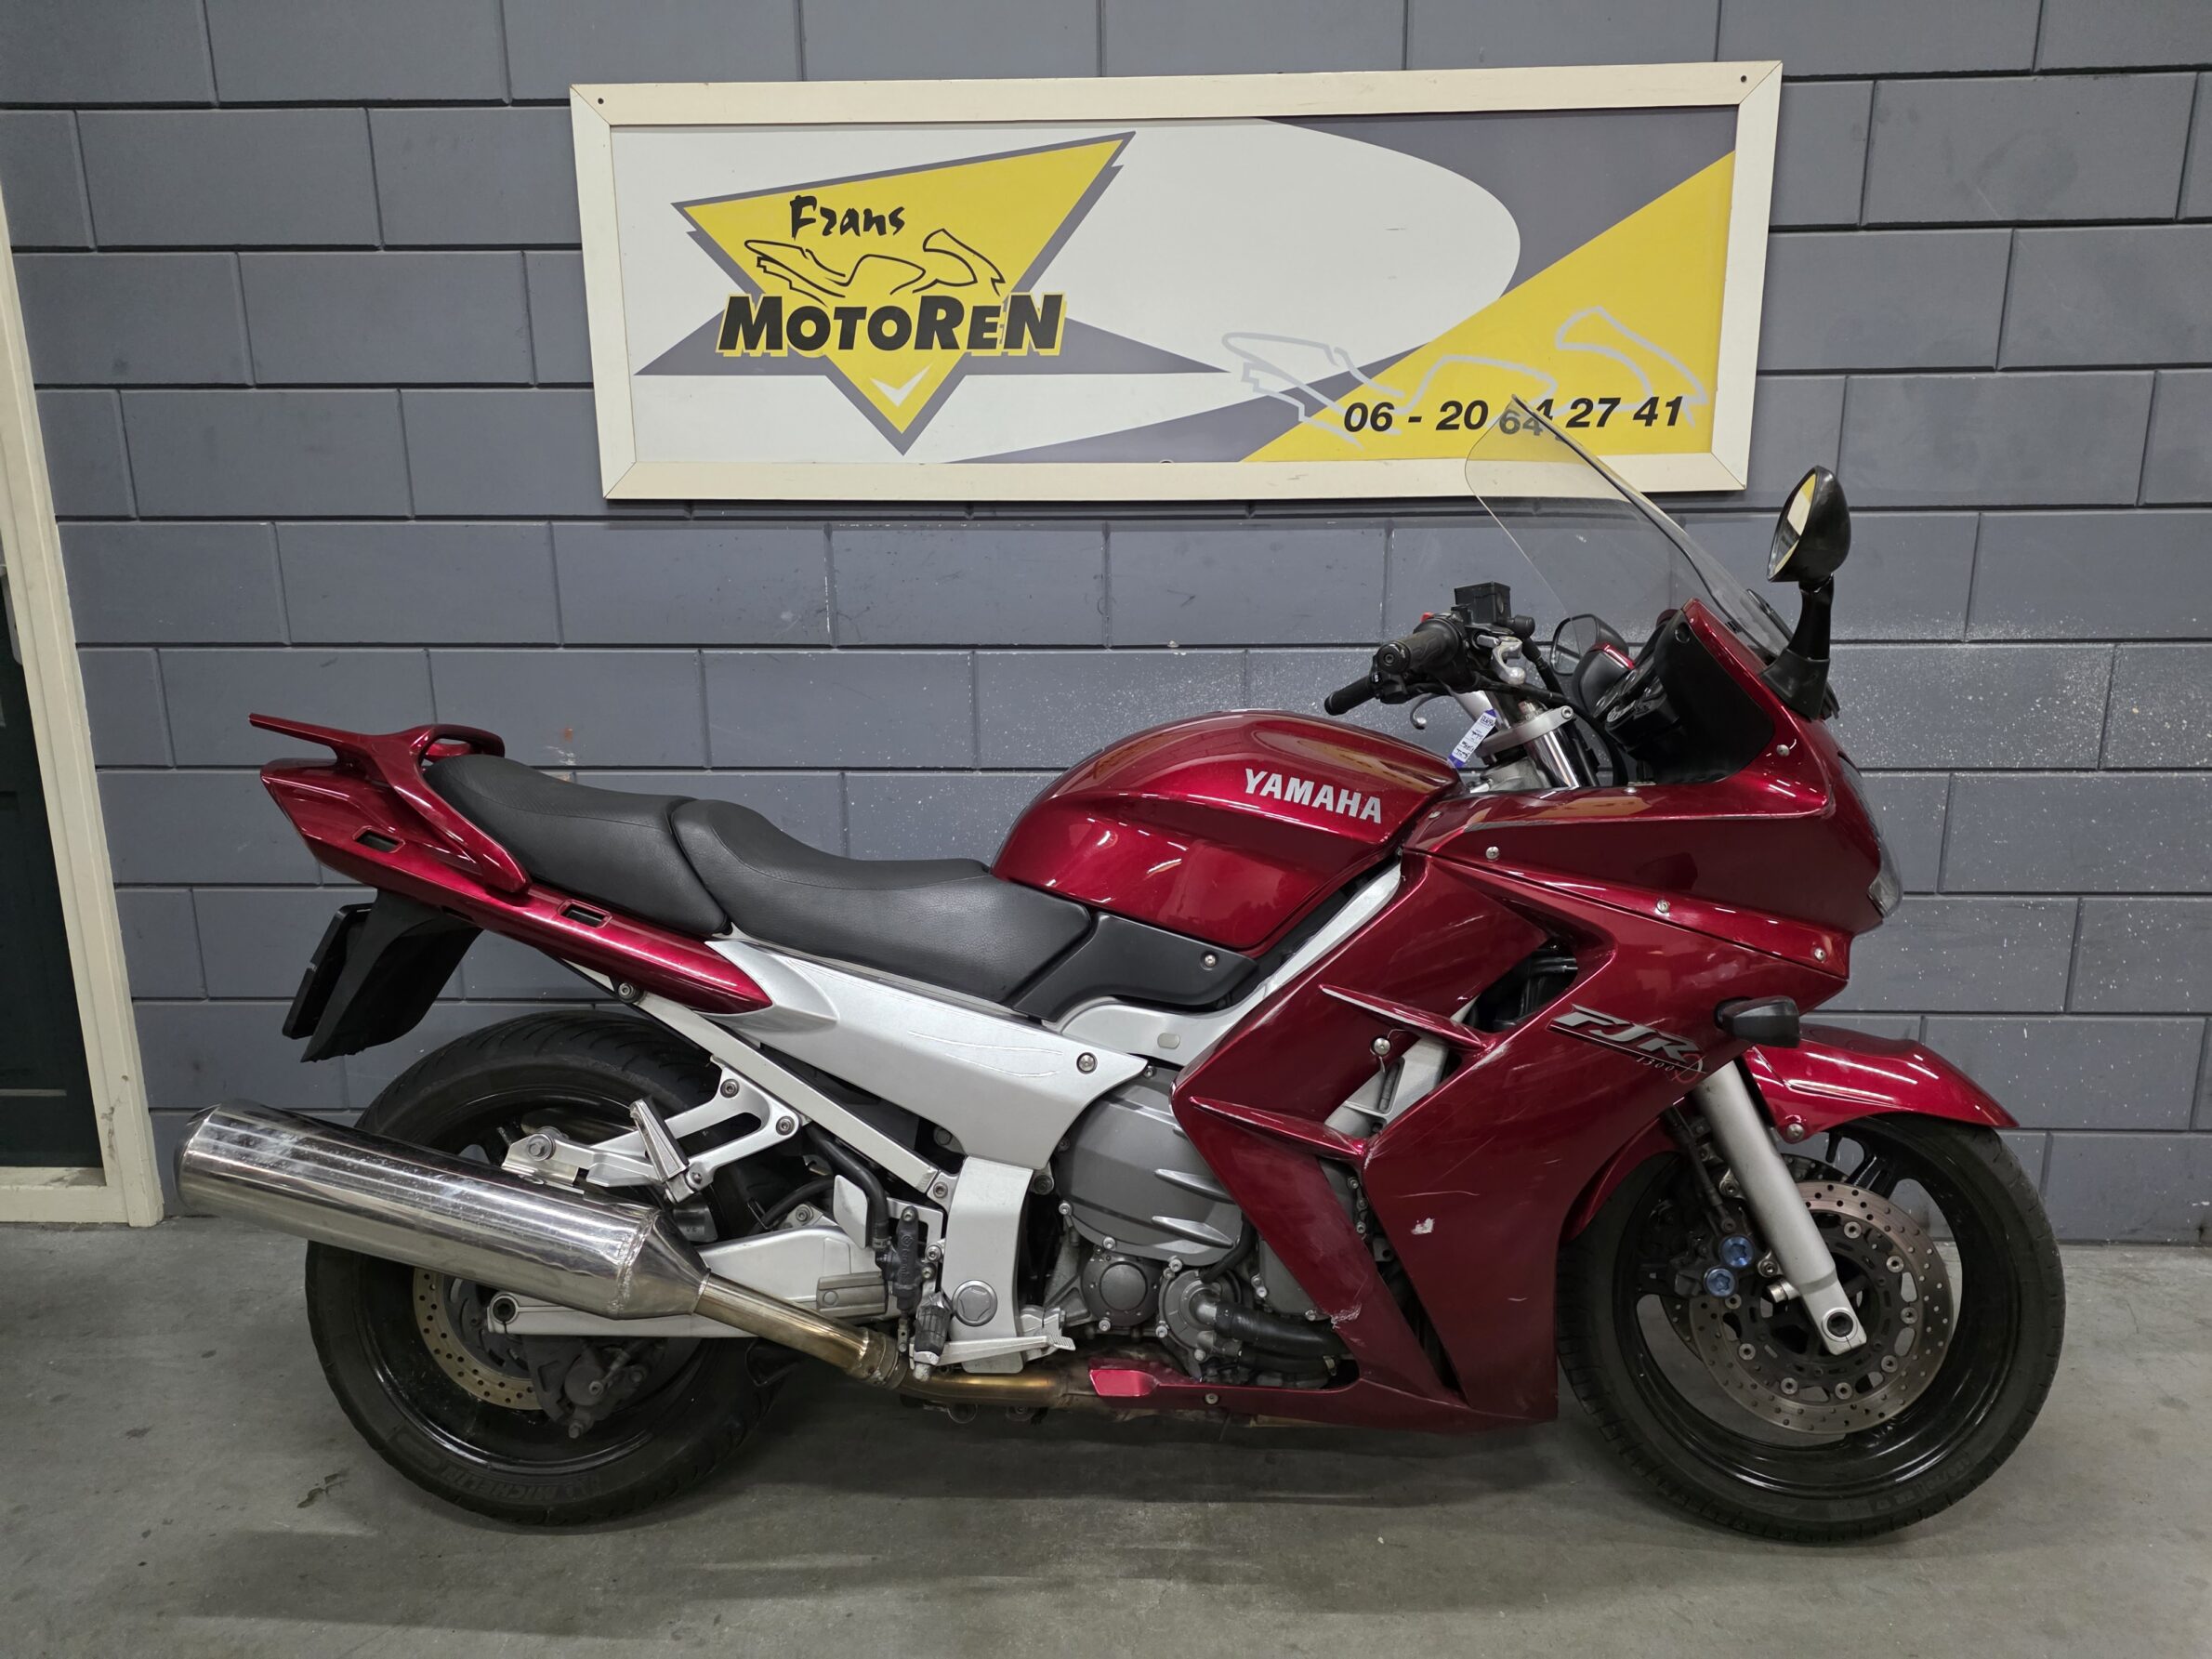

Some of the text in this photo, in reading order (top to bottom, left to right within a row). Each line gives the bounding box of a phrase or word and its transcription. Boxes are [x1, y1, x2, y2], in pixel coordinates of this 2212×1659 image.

[789, 195, 905, 239] Frans
[1343, 395, 1684, 437] 06 - 20 64 27 41
[1244, 768, 1382, 824] YAMAHA
[1551, 1003, 1703, 1064] FJR
[1636, 1056, 1676, 1072] 1300
[440, 1465, 560, 1502] MICHELIN
